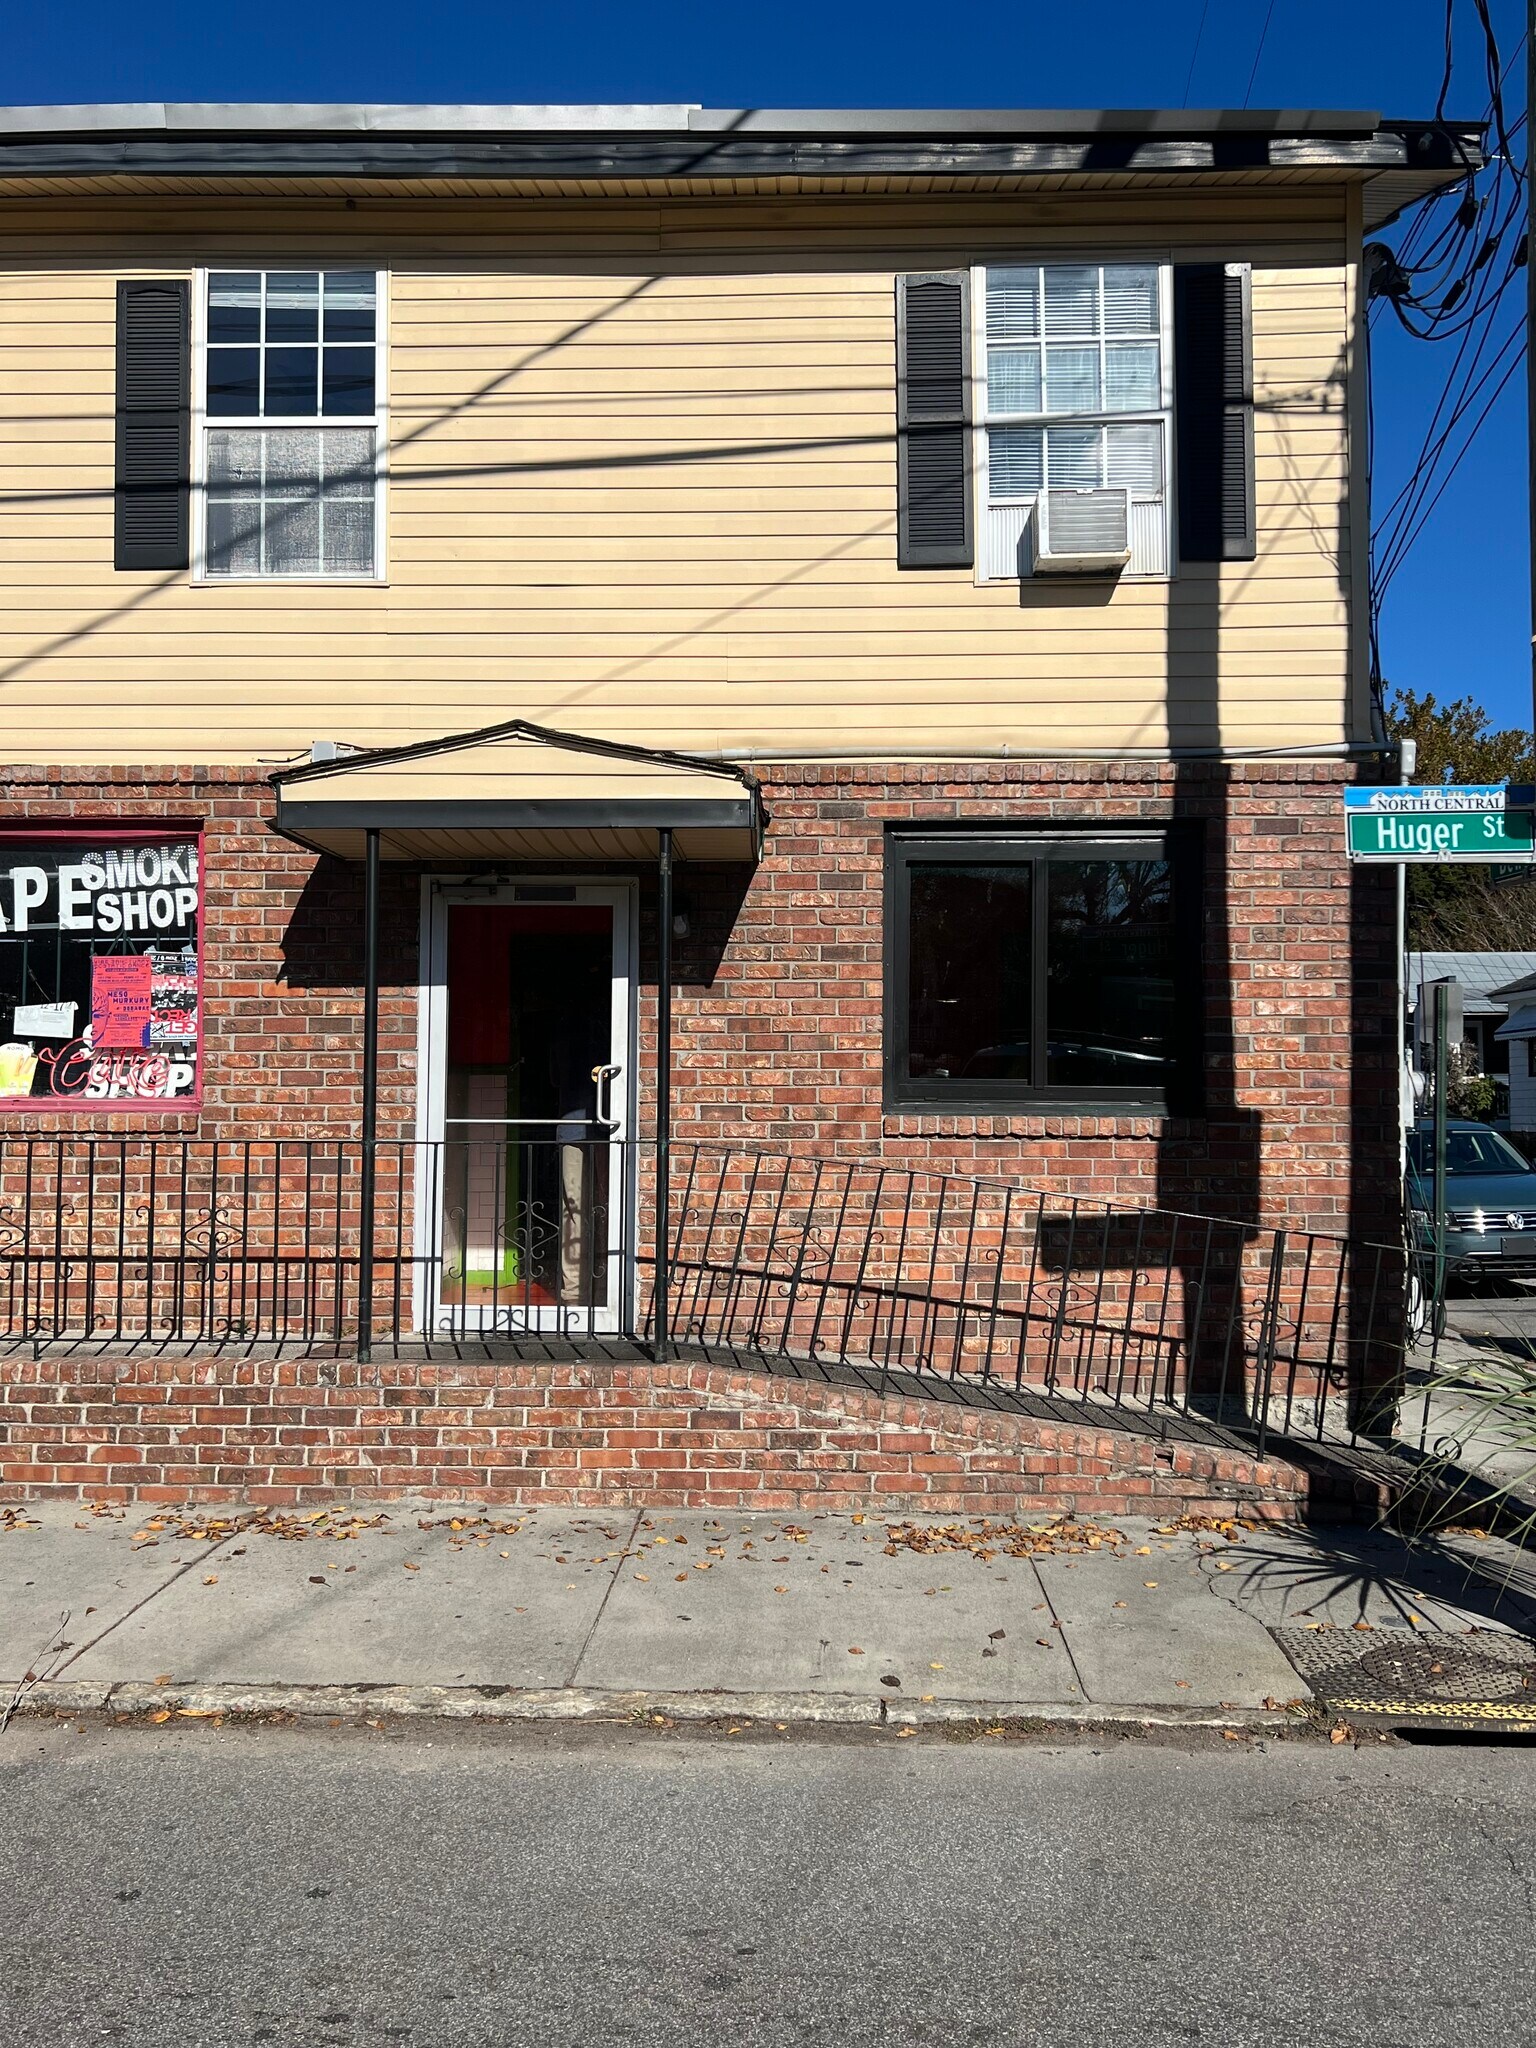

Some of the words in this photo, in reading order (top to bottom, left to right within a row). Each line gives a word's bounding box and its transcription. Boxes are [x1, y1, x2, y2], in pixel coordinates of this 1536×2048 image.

[1377, 798, 1430, 811] NORTH
[1434, 797, 1504, 811] CENTRAL
[1377, 816, 1464, 854] Huger
[1482, 815, 1505, 838] St
[96, 887, 198, 932] SHOP
[165, 1020, 197, 1034] GET
